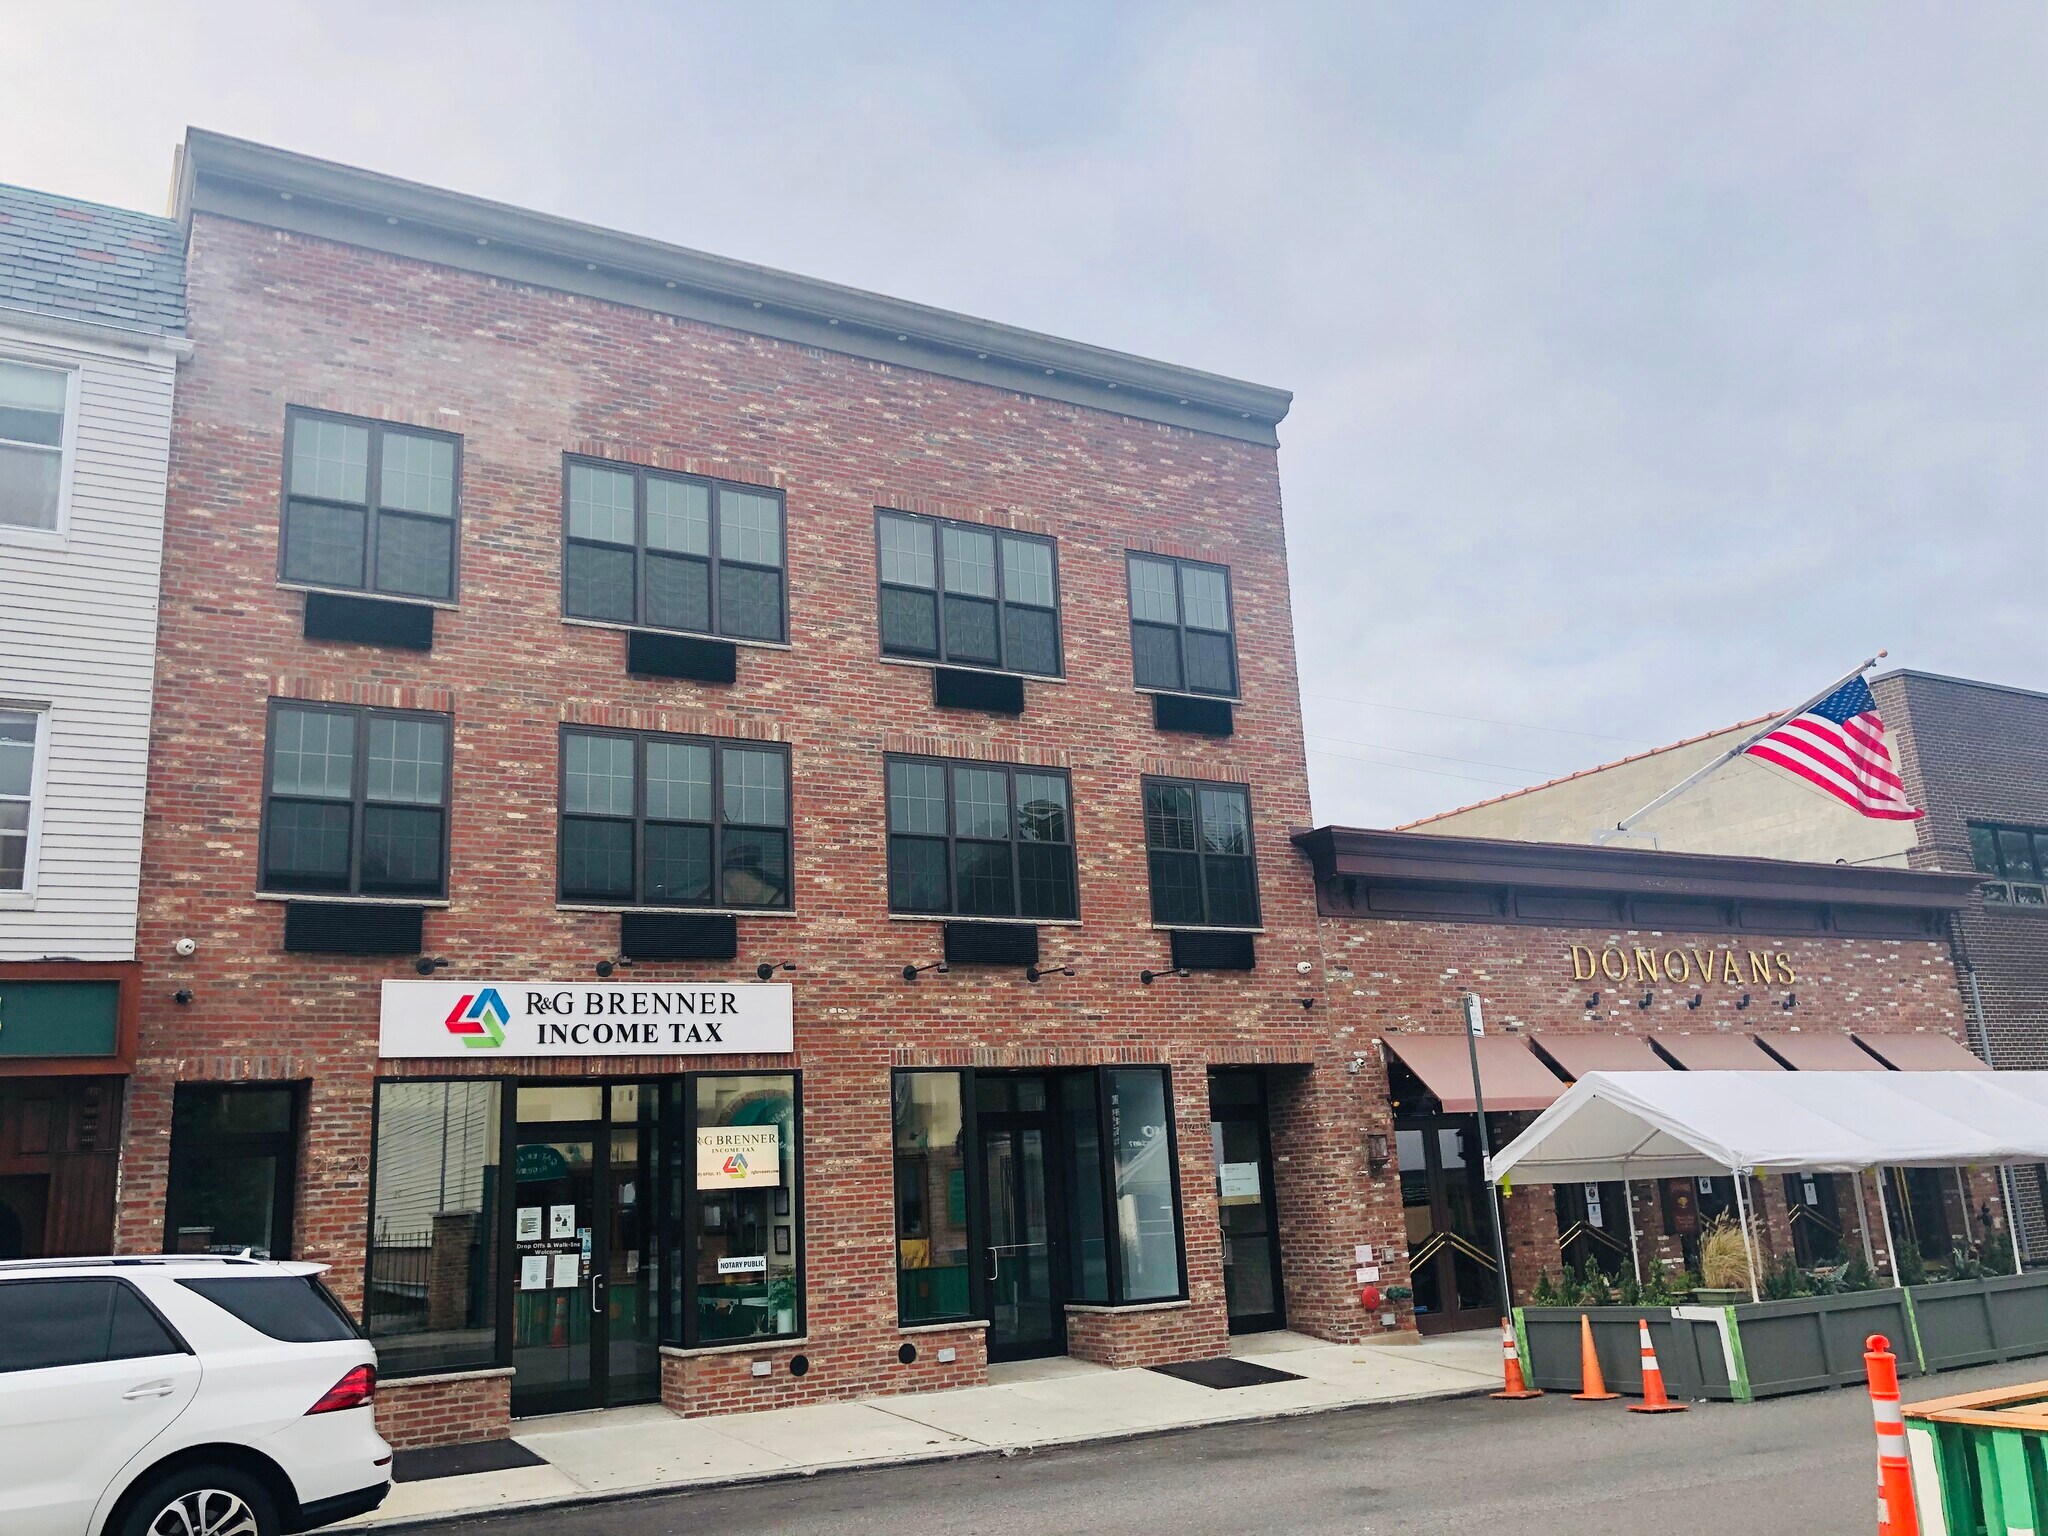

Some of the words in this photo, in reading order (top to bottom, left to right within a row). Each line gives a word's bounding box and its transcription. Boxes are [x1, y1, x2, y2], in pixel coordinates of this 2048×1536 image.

[1570, 944, 1796, 985] DONOVANS
[525, 991, 574, 1015] R&G
[584, 992, 739, 1015] BRENNER
[537, 1023, 659, 1045] INCOME
[668, 1022, 723, 1043] TAX
[716, 1133, 776, 1145] BRENNER
[720, 1261, 743, 1269] NOTARY
[743, 1260, 764, 1268] PUBLIC
